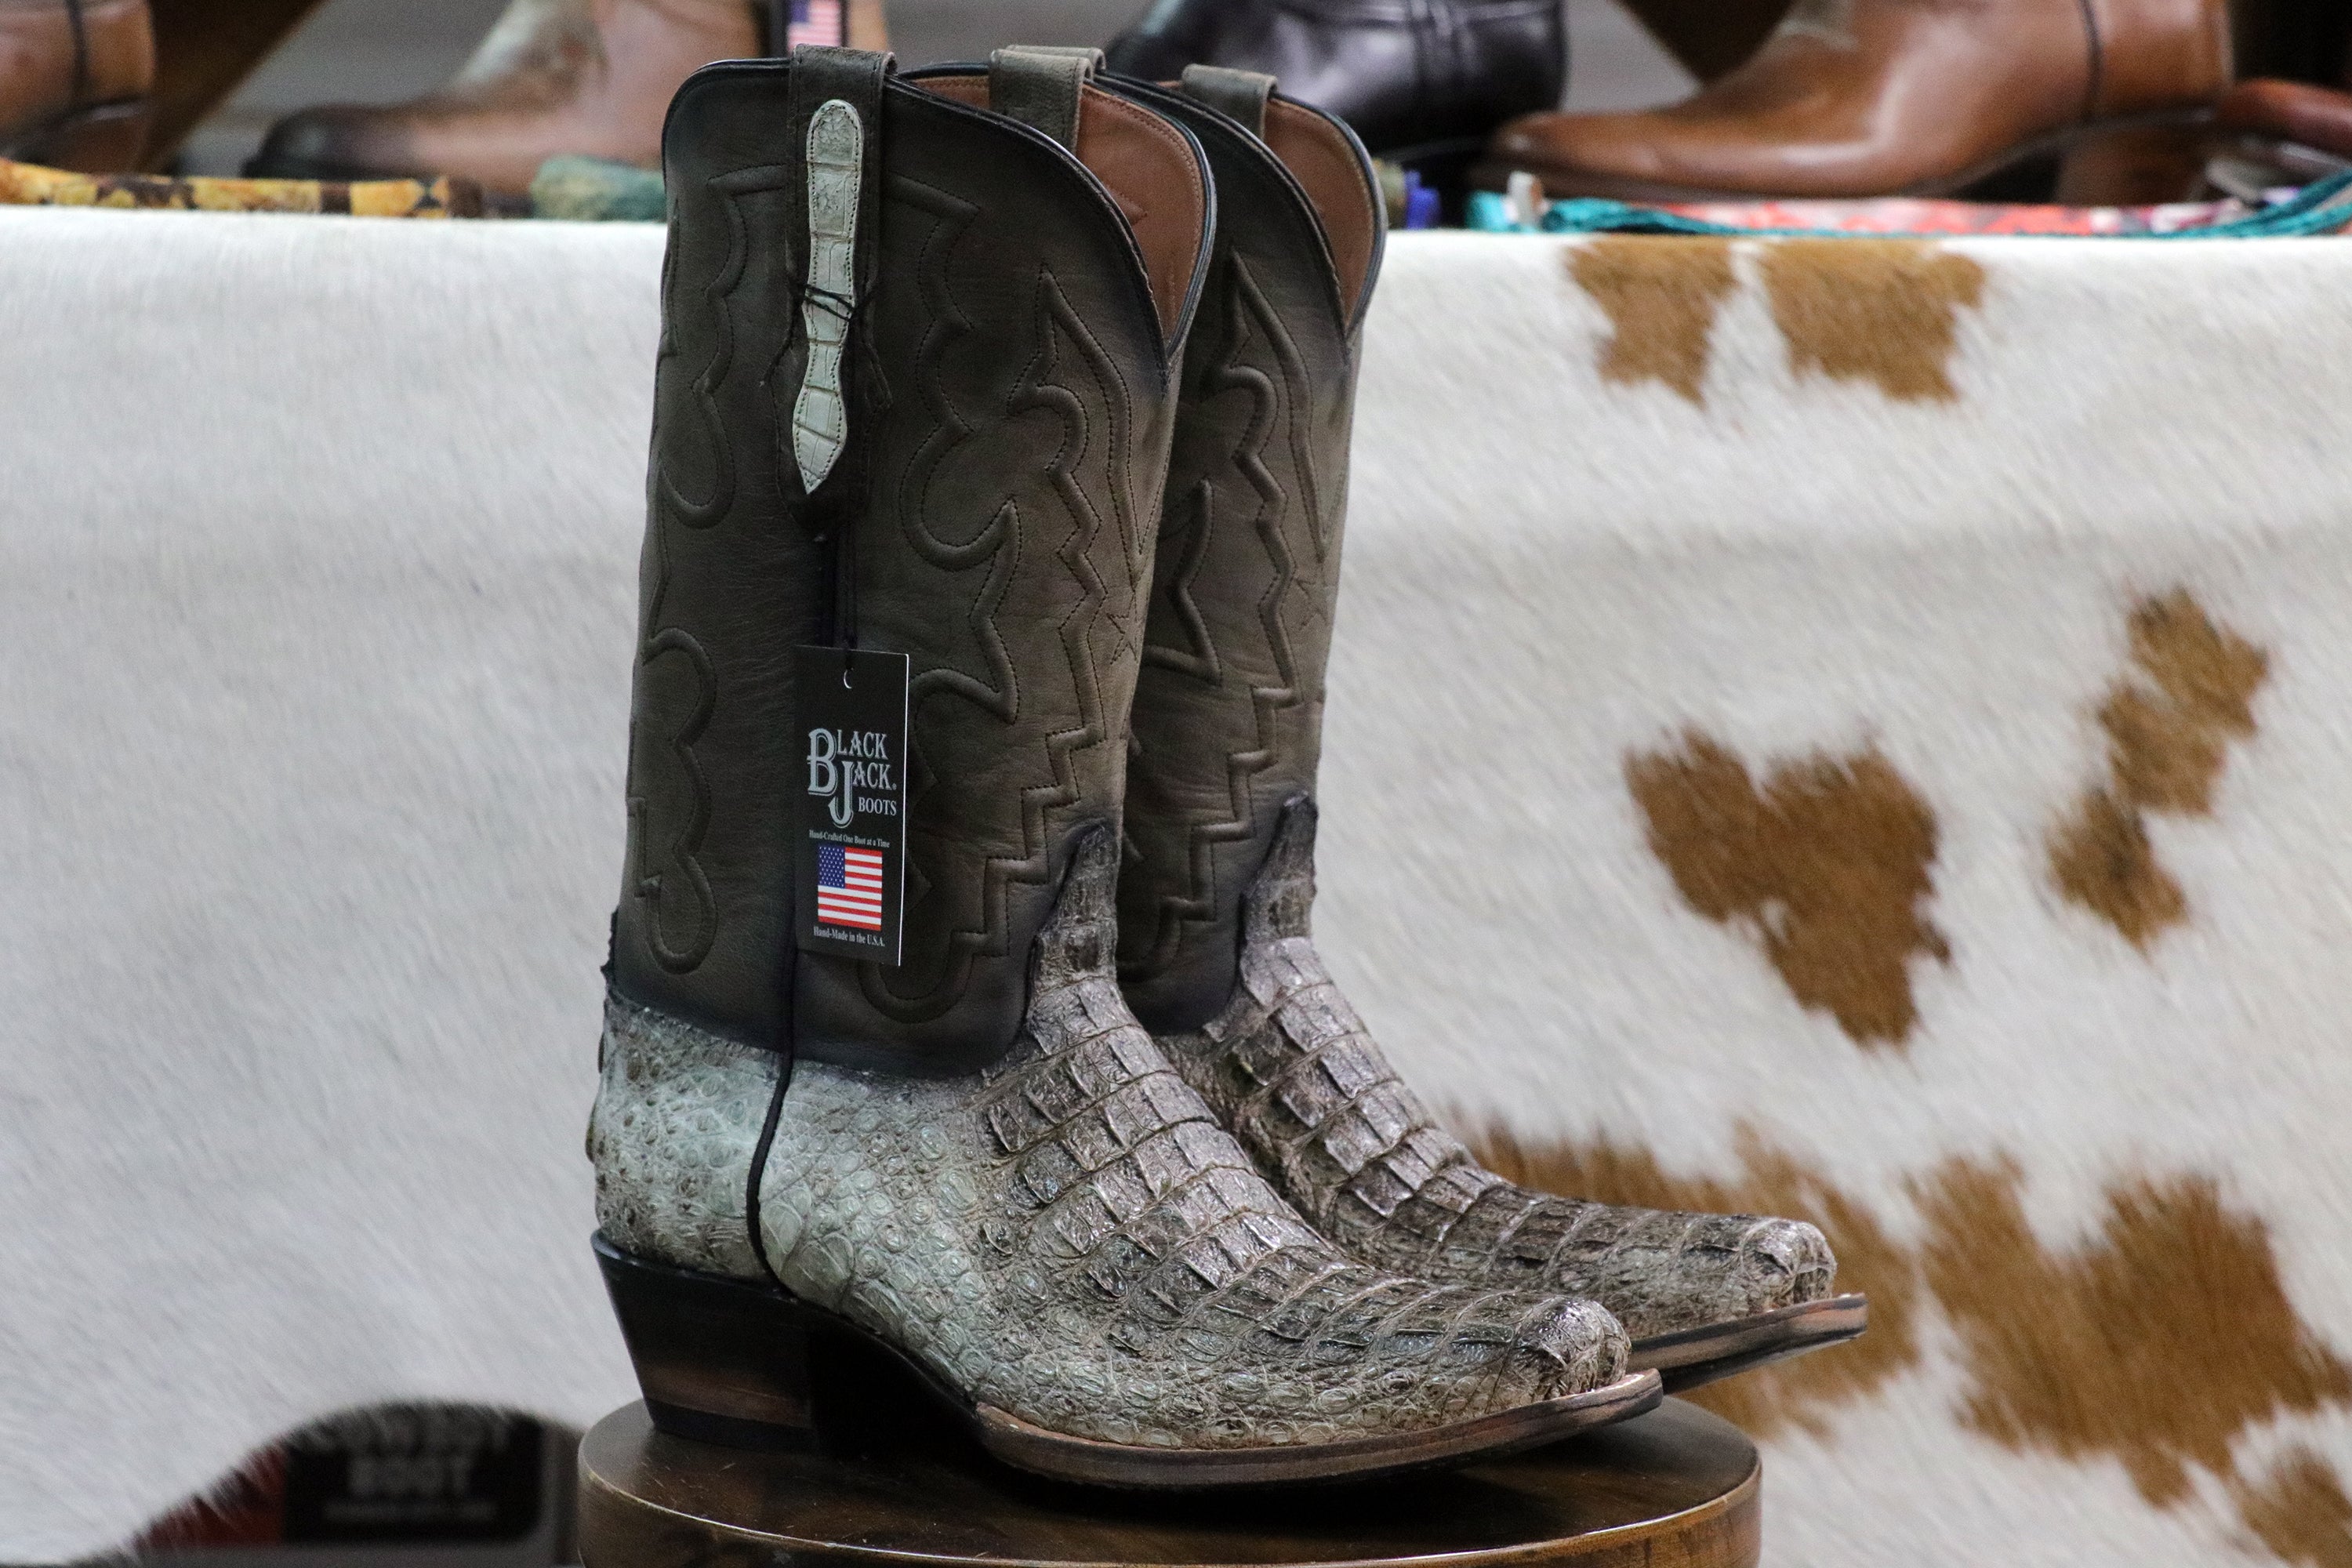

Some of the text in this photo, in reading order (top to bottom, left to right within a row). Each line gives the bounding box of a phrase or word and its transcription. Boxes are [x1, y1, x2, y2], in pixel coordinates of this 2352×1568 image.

[807, 728, 888, 796] BLACK
[858, 797, 896, 815] BOOTS
[809, 829, 842, 841] Hand-Crafted
[843, 834, 853, 843] One
[855, 836, 866, 844] Boot
[877, 838, 891, 848] Time
[814, 926, 885, 947] Hand-Made in the U.S.A.
